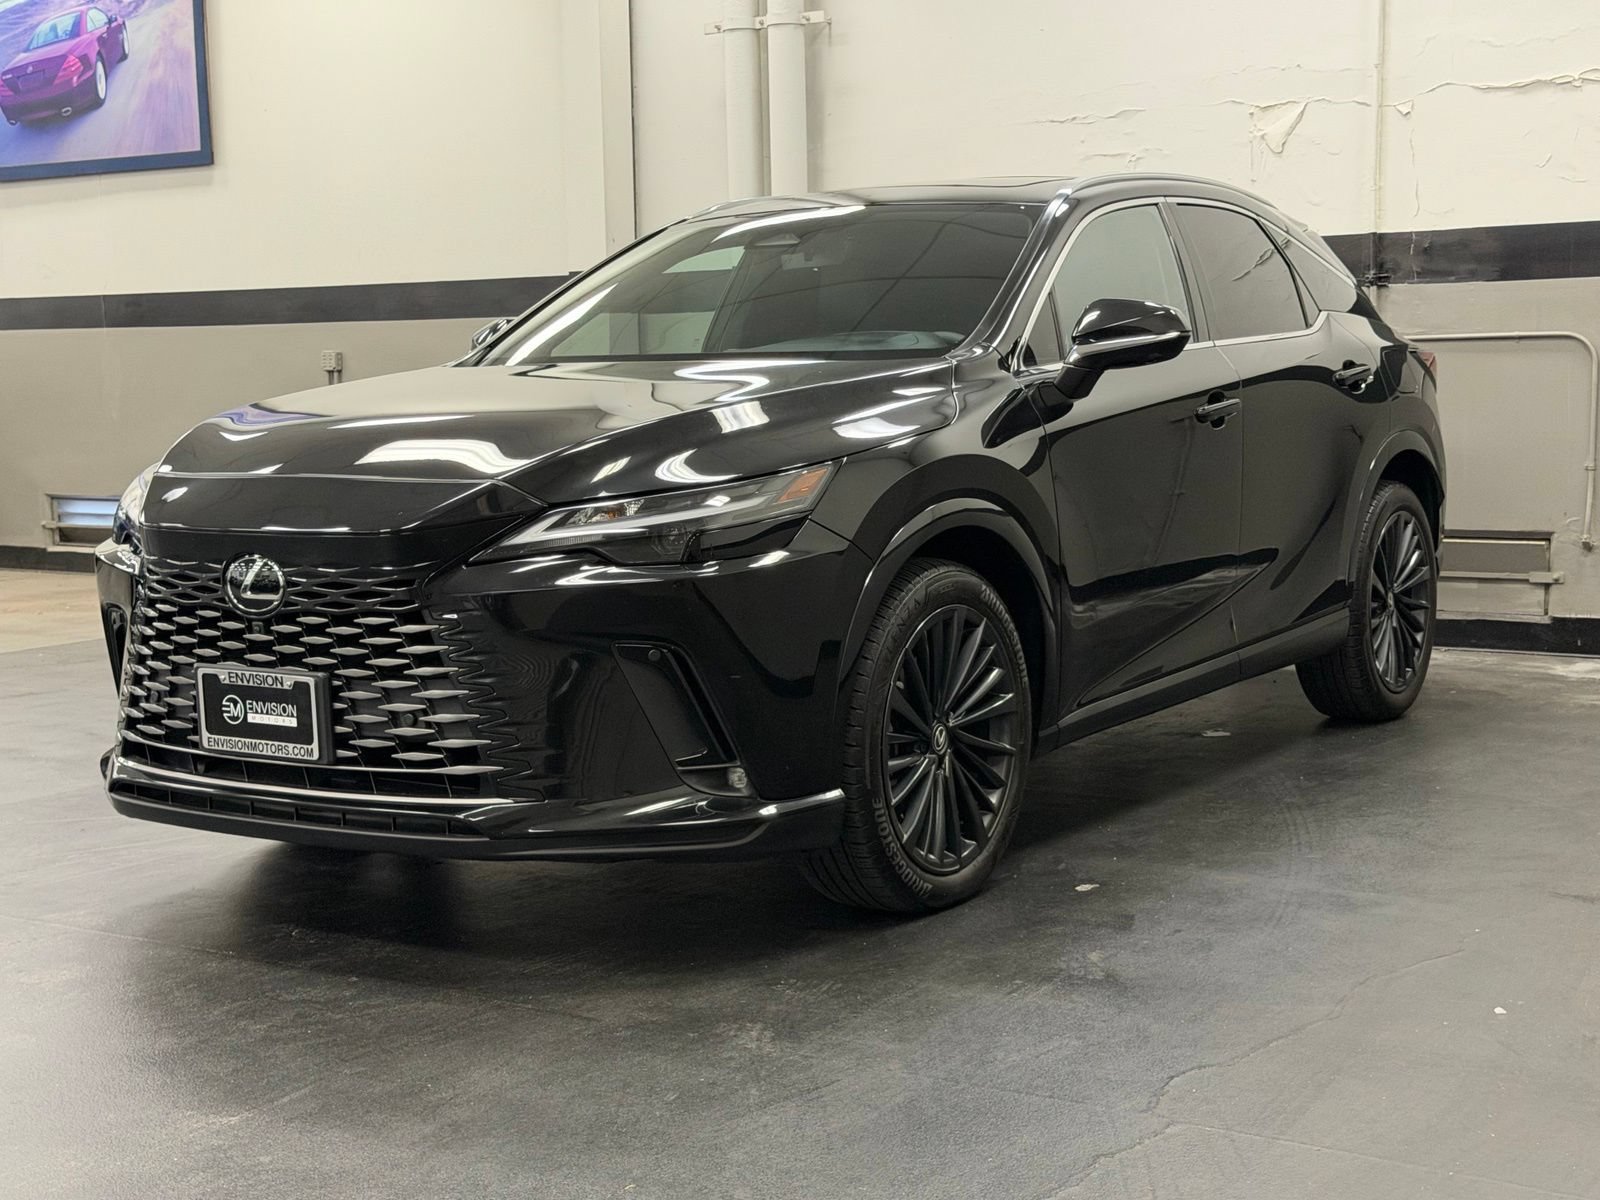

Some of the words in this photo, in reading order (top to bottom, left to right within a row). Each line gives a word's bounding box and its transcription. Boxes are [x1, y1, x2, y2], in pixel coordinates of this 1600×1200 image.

[980, 584, 1028, 688] BRIDGESTONE
[227, 671, 284, 688] ENVISION
[246, 700, 297, 717] ENVISION
[207, 736, 314, 758] ENVISIONMOTORS.COM
[872, 797, 934, 898] BRIDGESTONE
